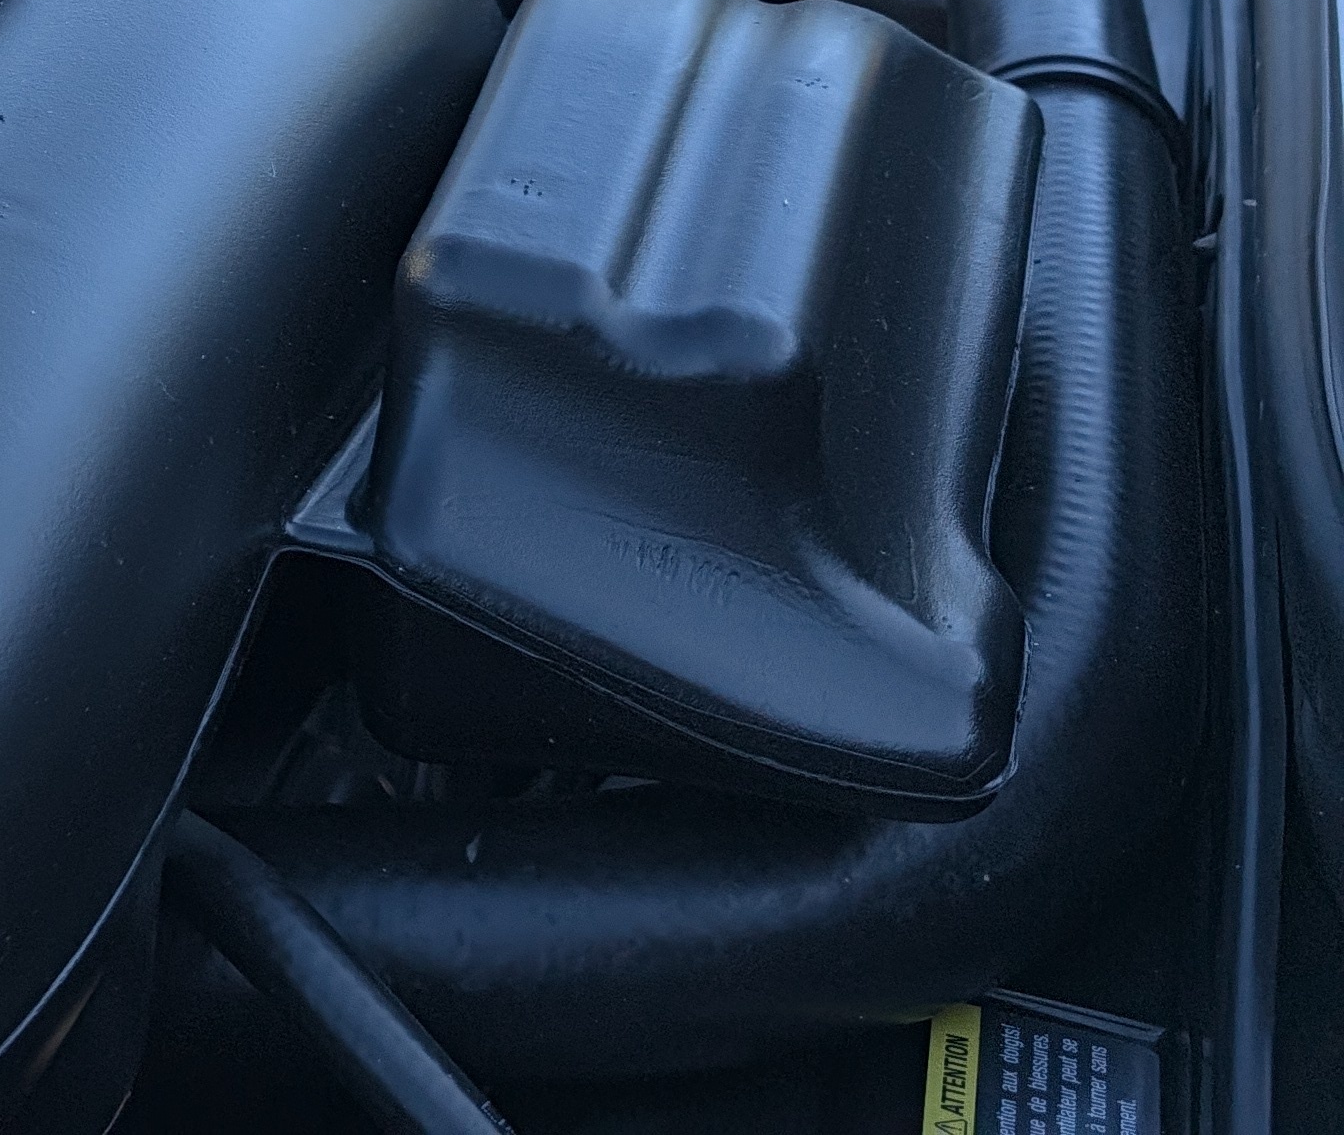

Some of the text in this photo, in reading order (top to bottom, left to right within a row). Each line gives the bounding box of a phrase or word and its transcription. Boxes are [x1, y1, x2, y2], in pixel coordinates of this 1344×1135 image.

[999, 1023, 1024, 1064] doigts!
[1063, 1038, 1078, 1054] se
[1027, 1034, 1049, 1091] blessures.
[1058, 1055, 1081, 1084] peut
[1091, 1045, 1108, 1073] sans
[940, 1033, 969, 1117] ATTENTION
[1002, 1069, 1018, 1093] aux
[1027, 1096, 1046, 1113] de
